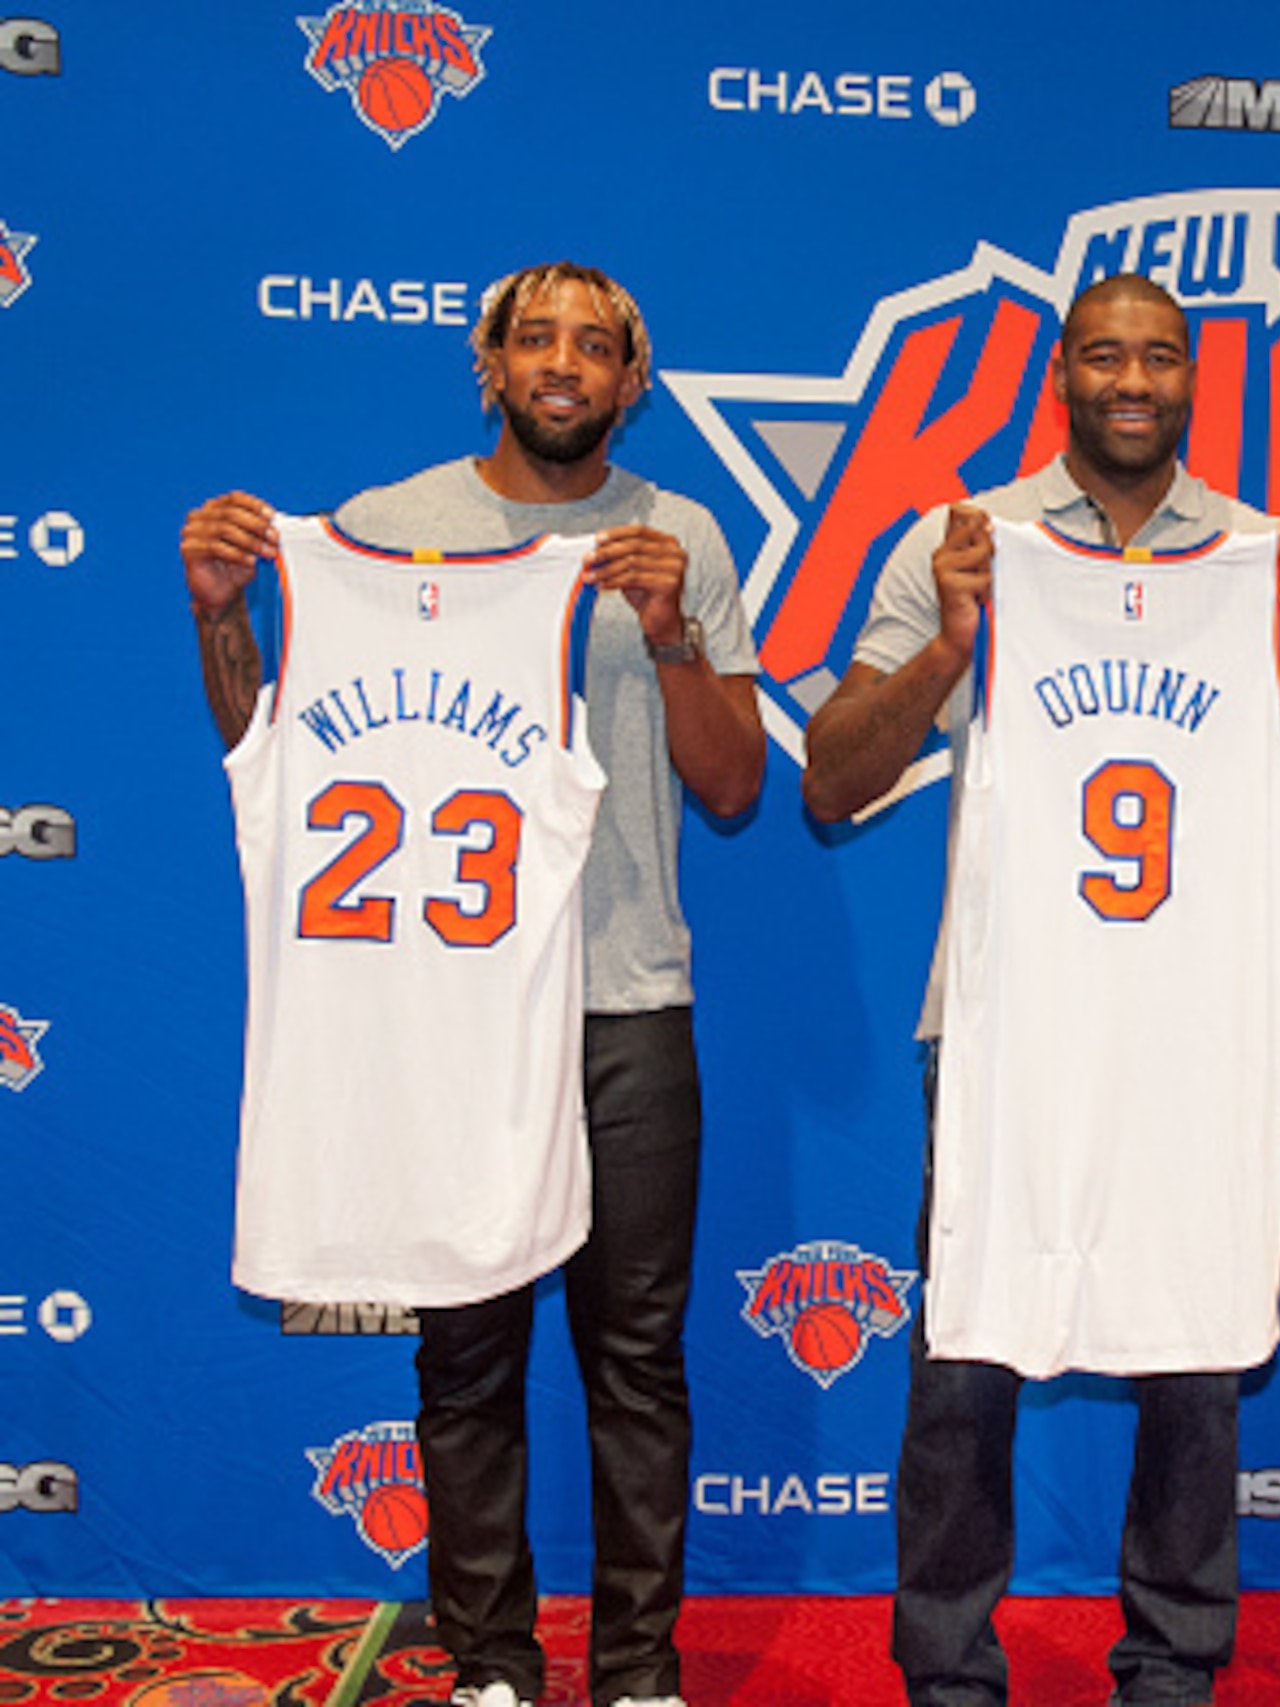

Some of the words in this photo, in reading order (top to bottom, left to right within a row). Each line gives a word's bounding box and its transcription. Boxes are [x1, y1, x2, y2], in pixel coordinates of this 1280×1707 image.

[312, 7, 478, 76] KNICKS
[709, 67, 912, 119] CHASE
[1076, 212, 1249, 302] NEW
[258, 275, 468, 326] CHASE
[298, 667, 547, 767] WILLIAMS
[296, 779, 523, 949] 23
[1078, 758, 1177, 922] 9
[749, 1259, 903, 1317] KNICKS
[319, 1440, 424, 1496] KNIC
[695, 1473, 889, 1515] CHASE
